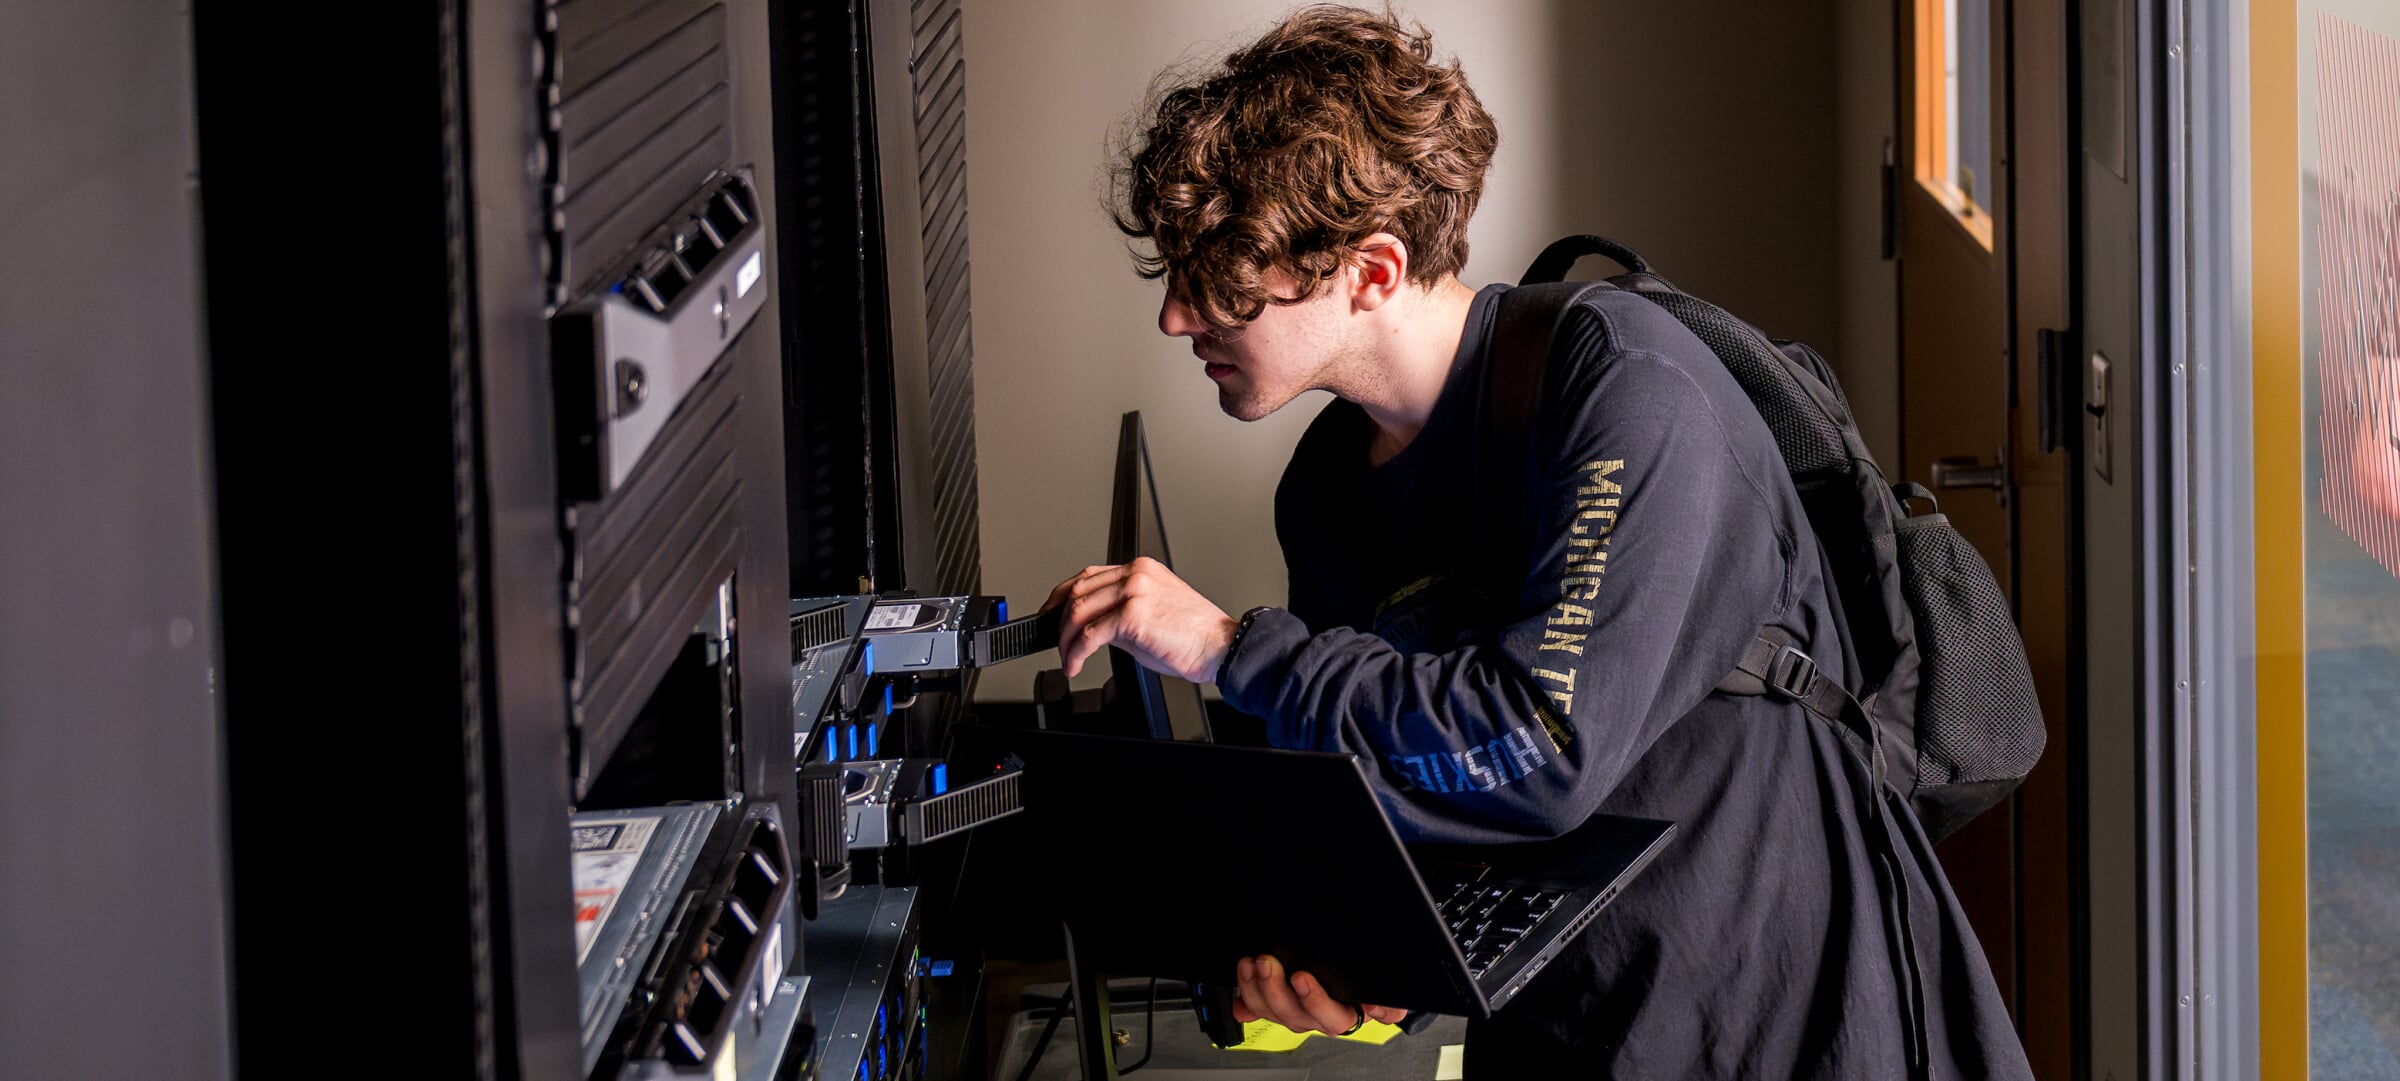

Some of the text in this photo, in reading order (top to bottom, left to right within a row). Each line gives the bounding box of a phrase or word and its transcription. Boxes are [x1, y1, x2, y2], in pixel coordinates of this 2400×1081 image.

[1531, 458, 1625, 754] MICHIGAN TEH
[1387, 726, 1547, 793] HUSKIES
